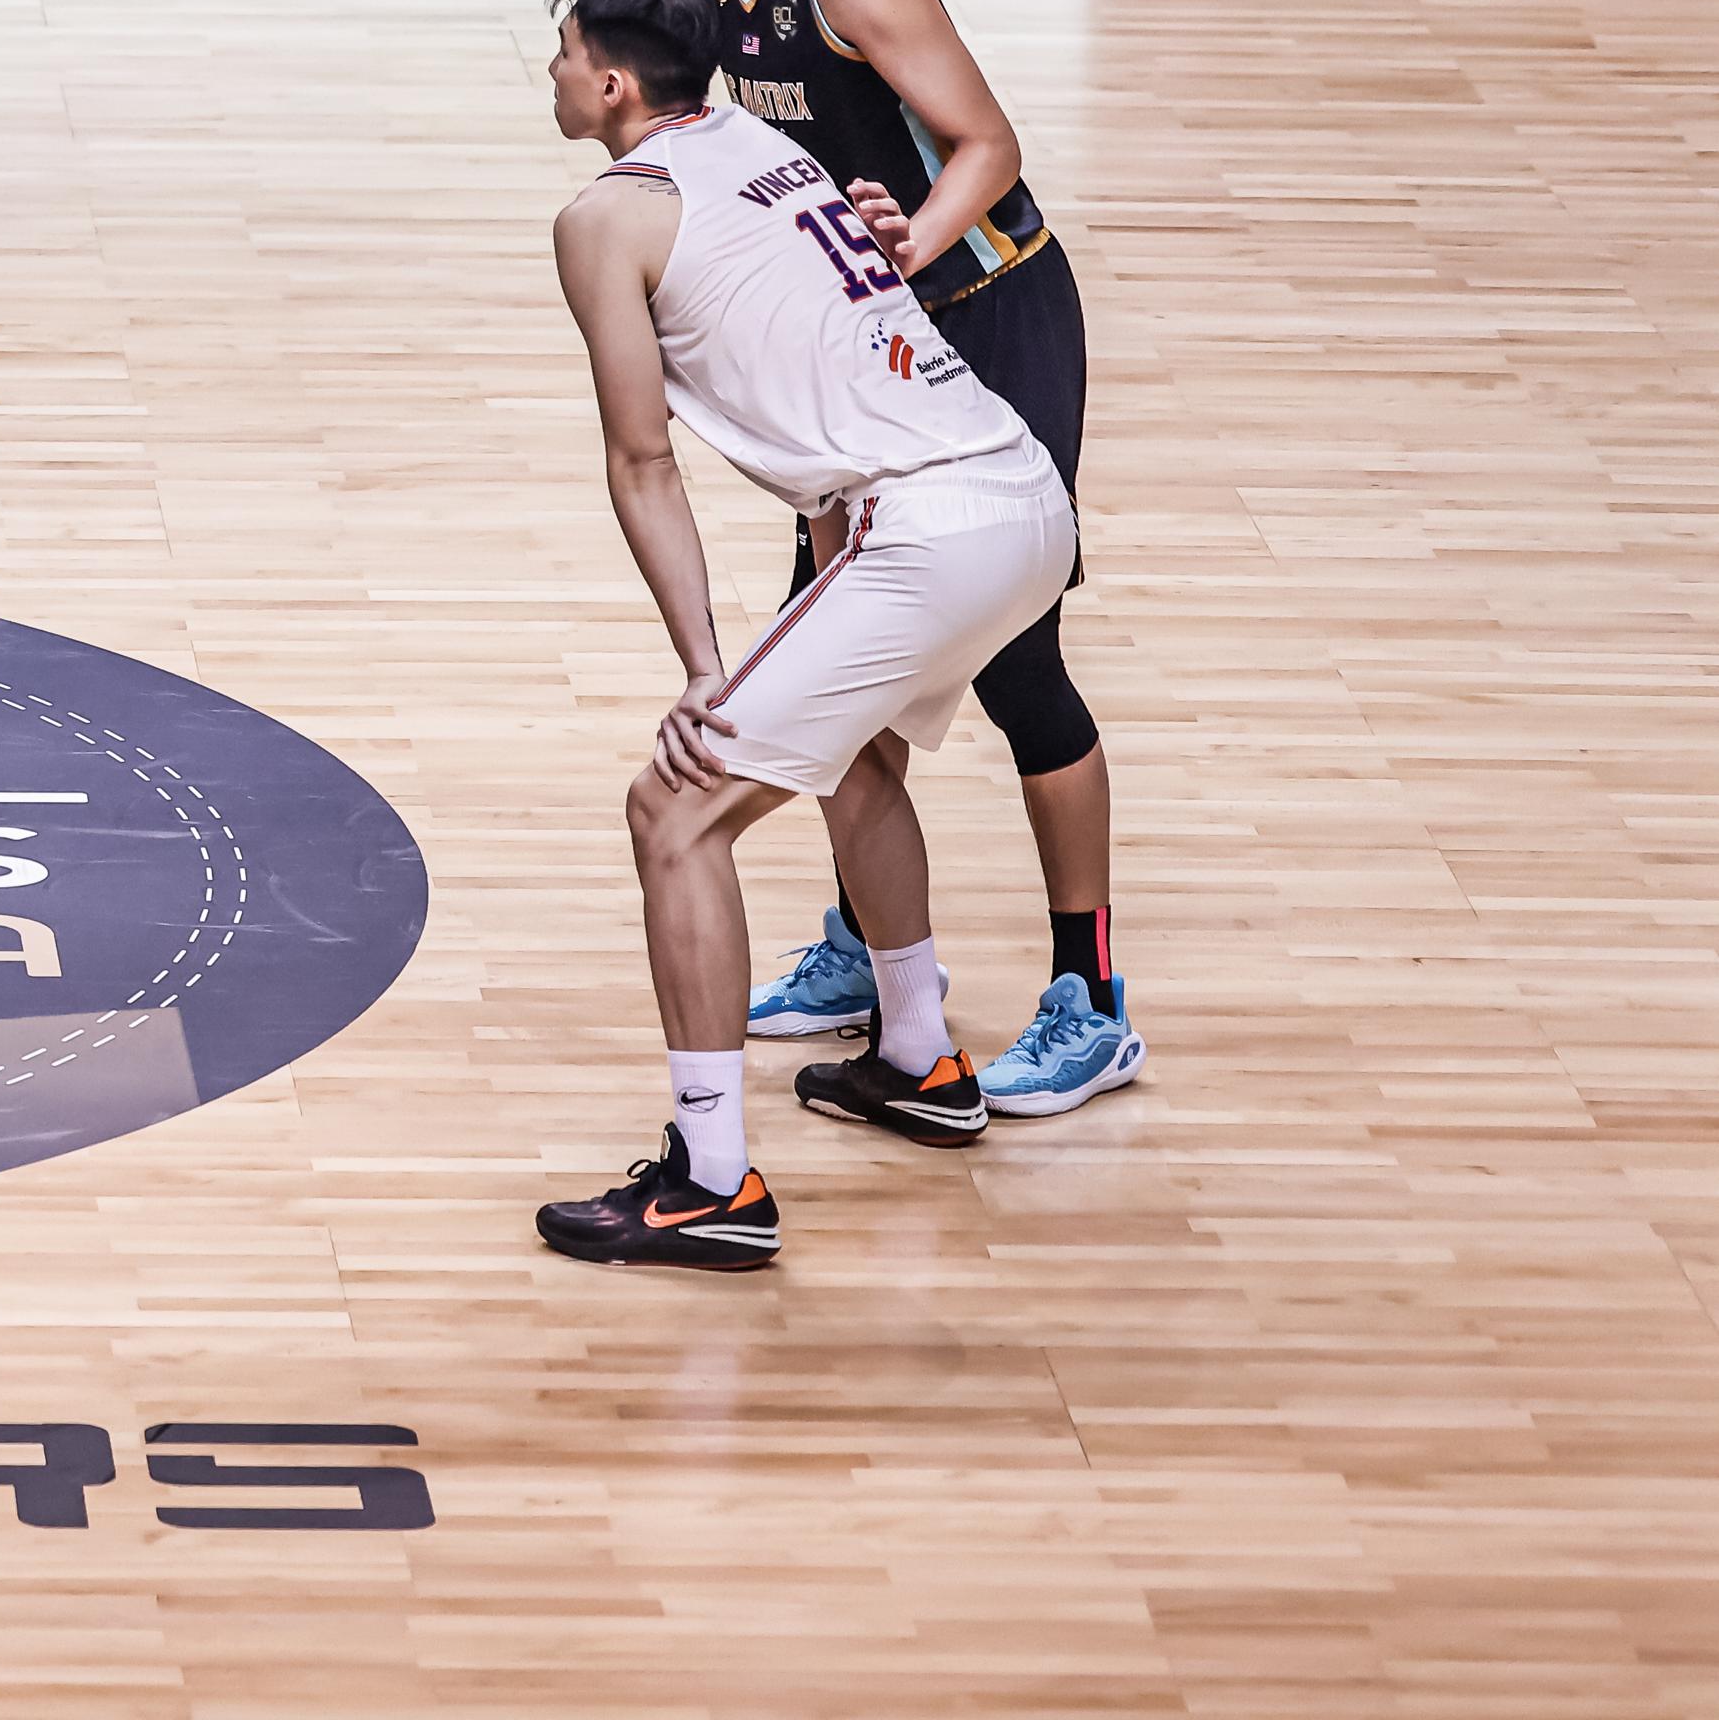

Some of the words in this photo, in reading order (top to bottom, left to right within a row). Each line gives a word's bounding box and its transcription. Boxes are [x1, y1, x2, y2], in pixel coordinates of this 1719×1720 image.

[740, 76, 815, 121] MATRIX
[738, 156, 830, 208] VINCEN
[795, 199, 904, 304] 15
[915, 353, 947, 375] Bakrie
[926, 363, 973, 388] Investmen
